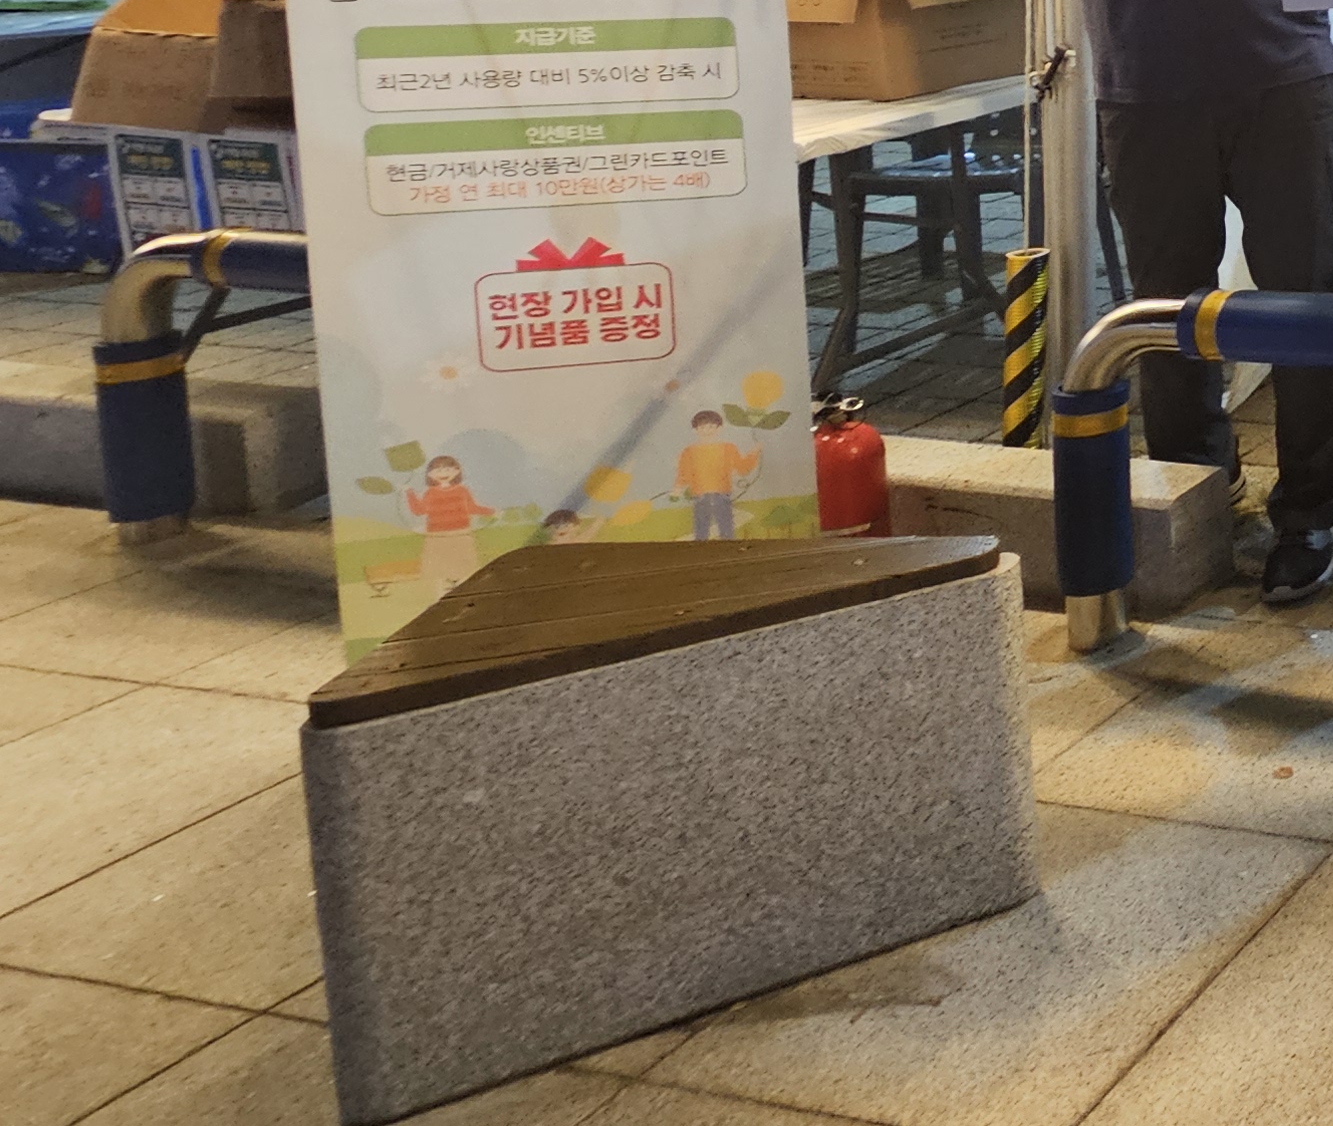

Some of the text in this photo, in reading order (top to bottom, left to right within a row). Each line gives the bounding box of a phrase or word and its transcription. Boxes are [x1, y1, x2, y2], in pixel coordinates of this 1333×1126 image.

[515, 26, 597, 47] 지급기준
[376, 72, 452, 92] 최근2년
[459, 69, 522, 89] 사용량
[529, 67, 571, 87] 대비
[656, 63, 696, 82] 감축
[701, 60, 722, 80] 시
[525, 124, 606, 146] 인센티브
[409, 185, 451, 206] 가정
[459, 184, 479, 204] 연
[485, 181, 528, 202] 최대
[673, 171, 712, 191] 4배)
[487, 282, 664, 321] 현장 가입 시
[495, 314, 662, 351] 기념품 증정
